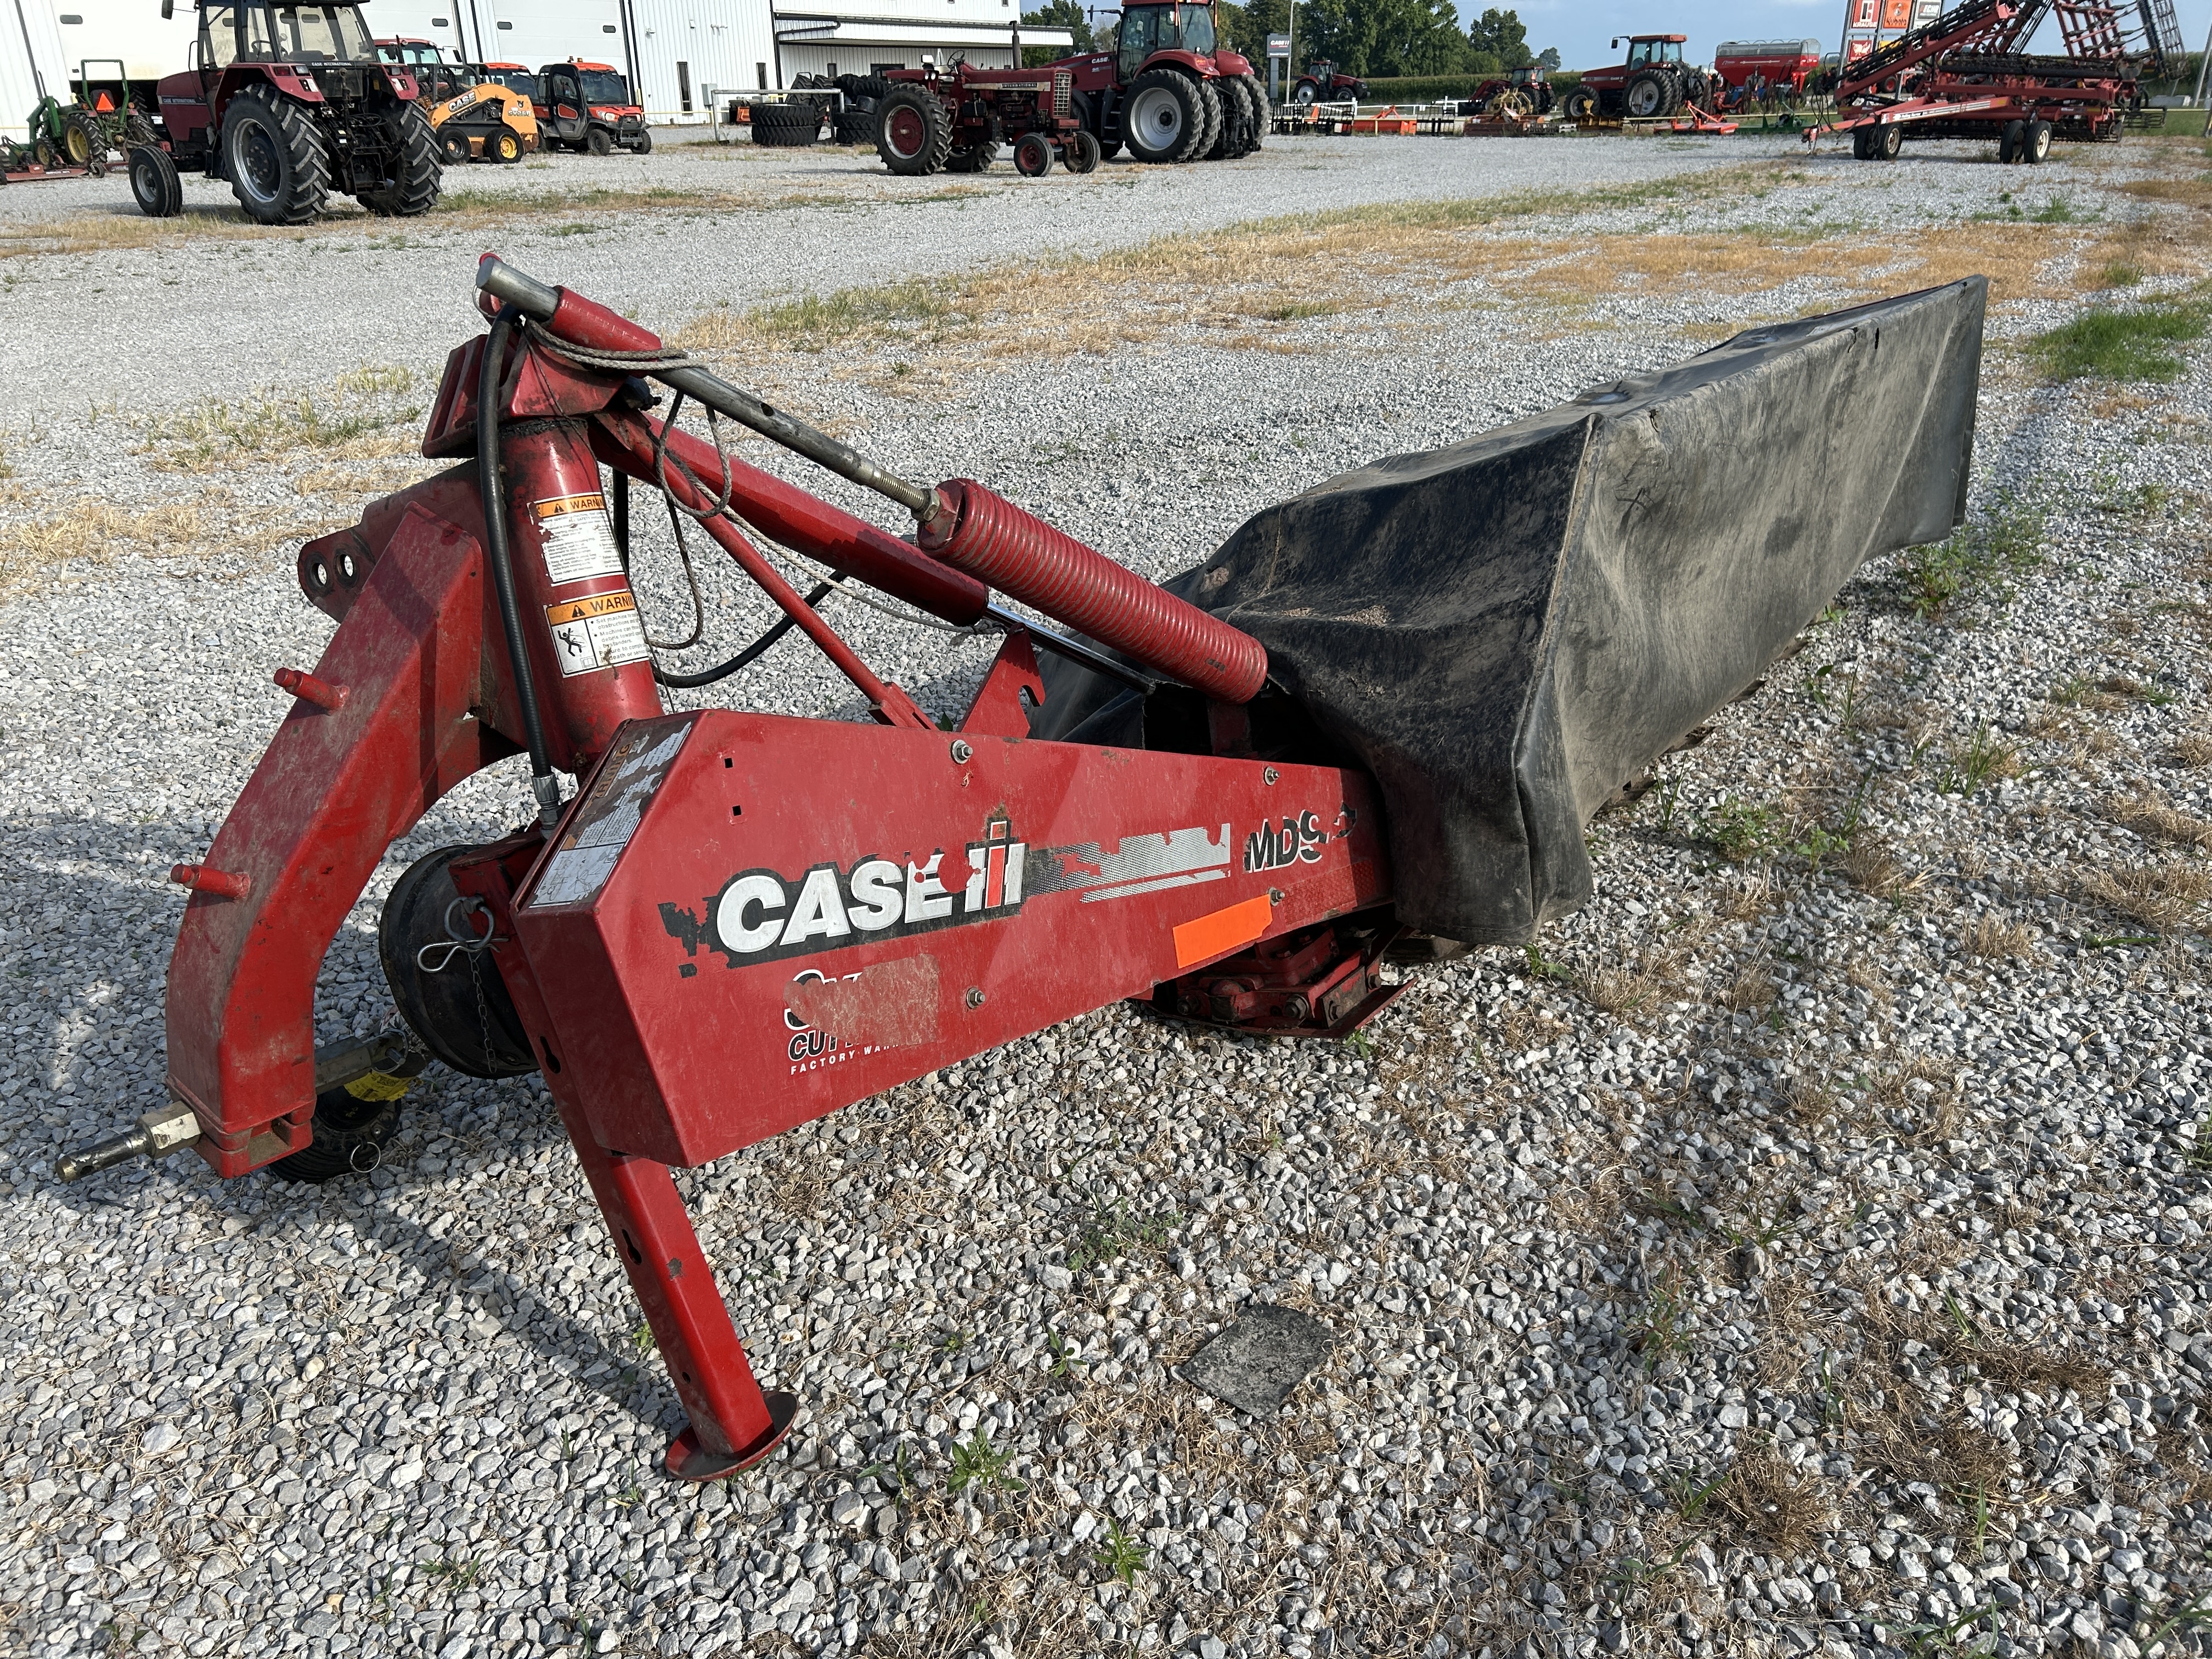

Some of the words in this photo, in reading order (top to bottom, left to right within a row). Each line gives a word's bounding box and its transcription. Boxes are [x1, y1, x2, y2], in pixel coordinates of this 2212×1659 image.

[449, 91, 477, 112] CASE
[600, 628, 622, 636] Machine
[716, 853, 953, 953] CASE
[790, 1049, 856, 1076] FACTORY
